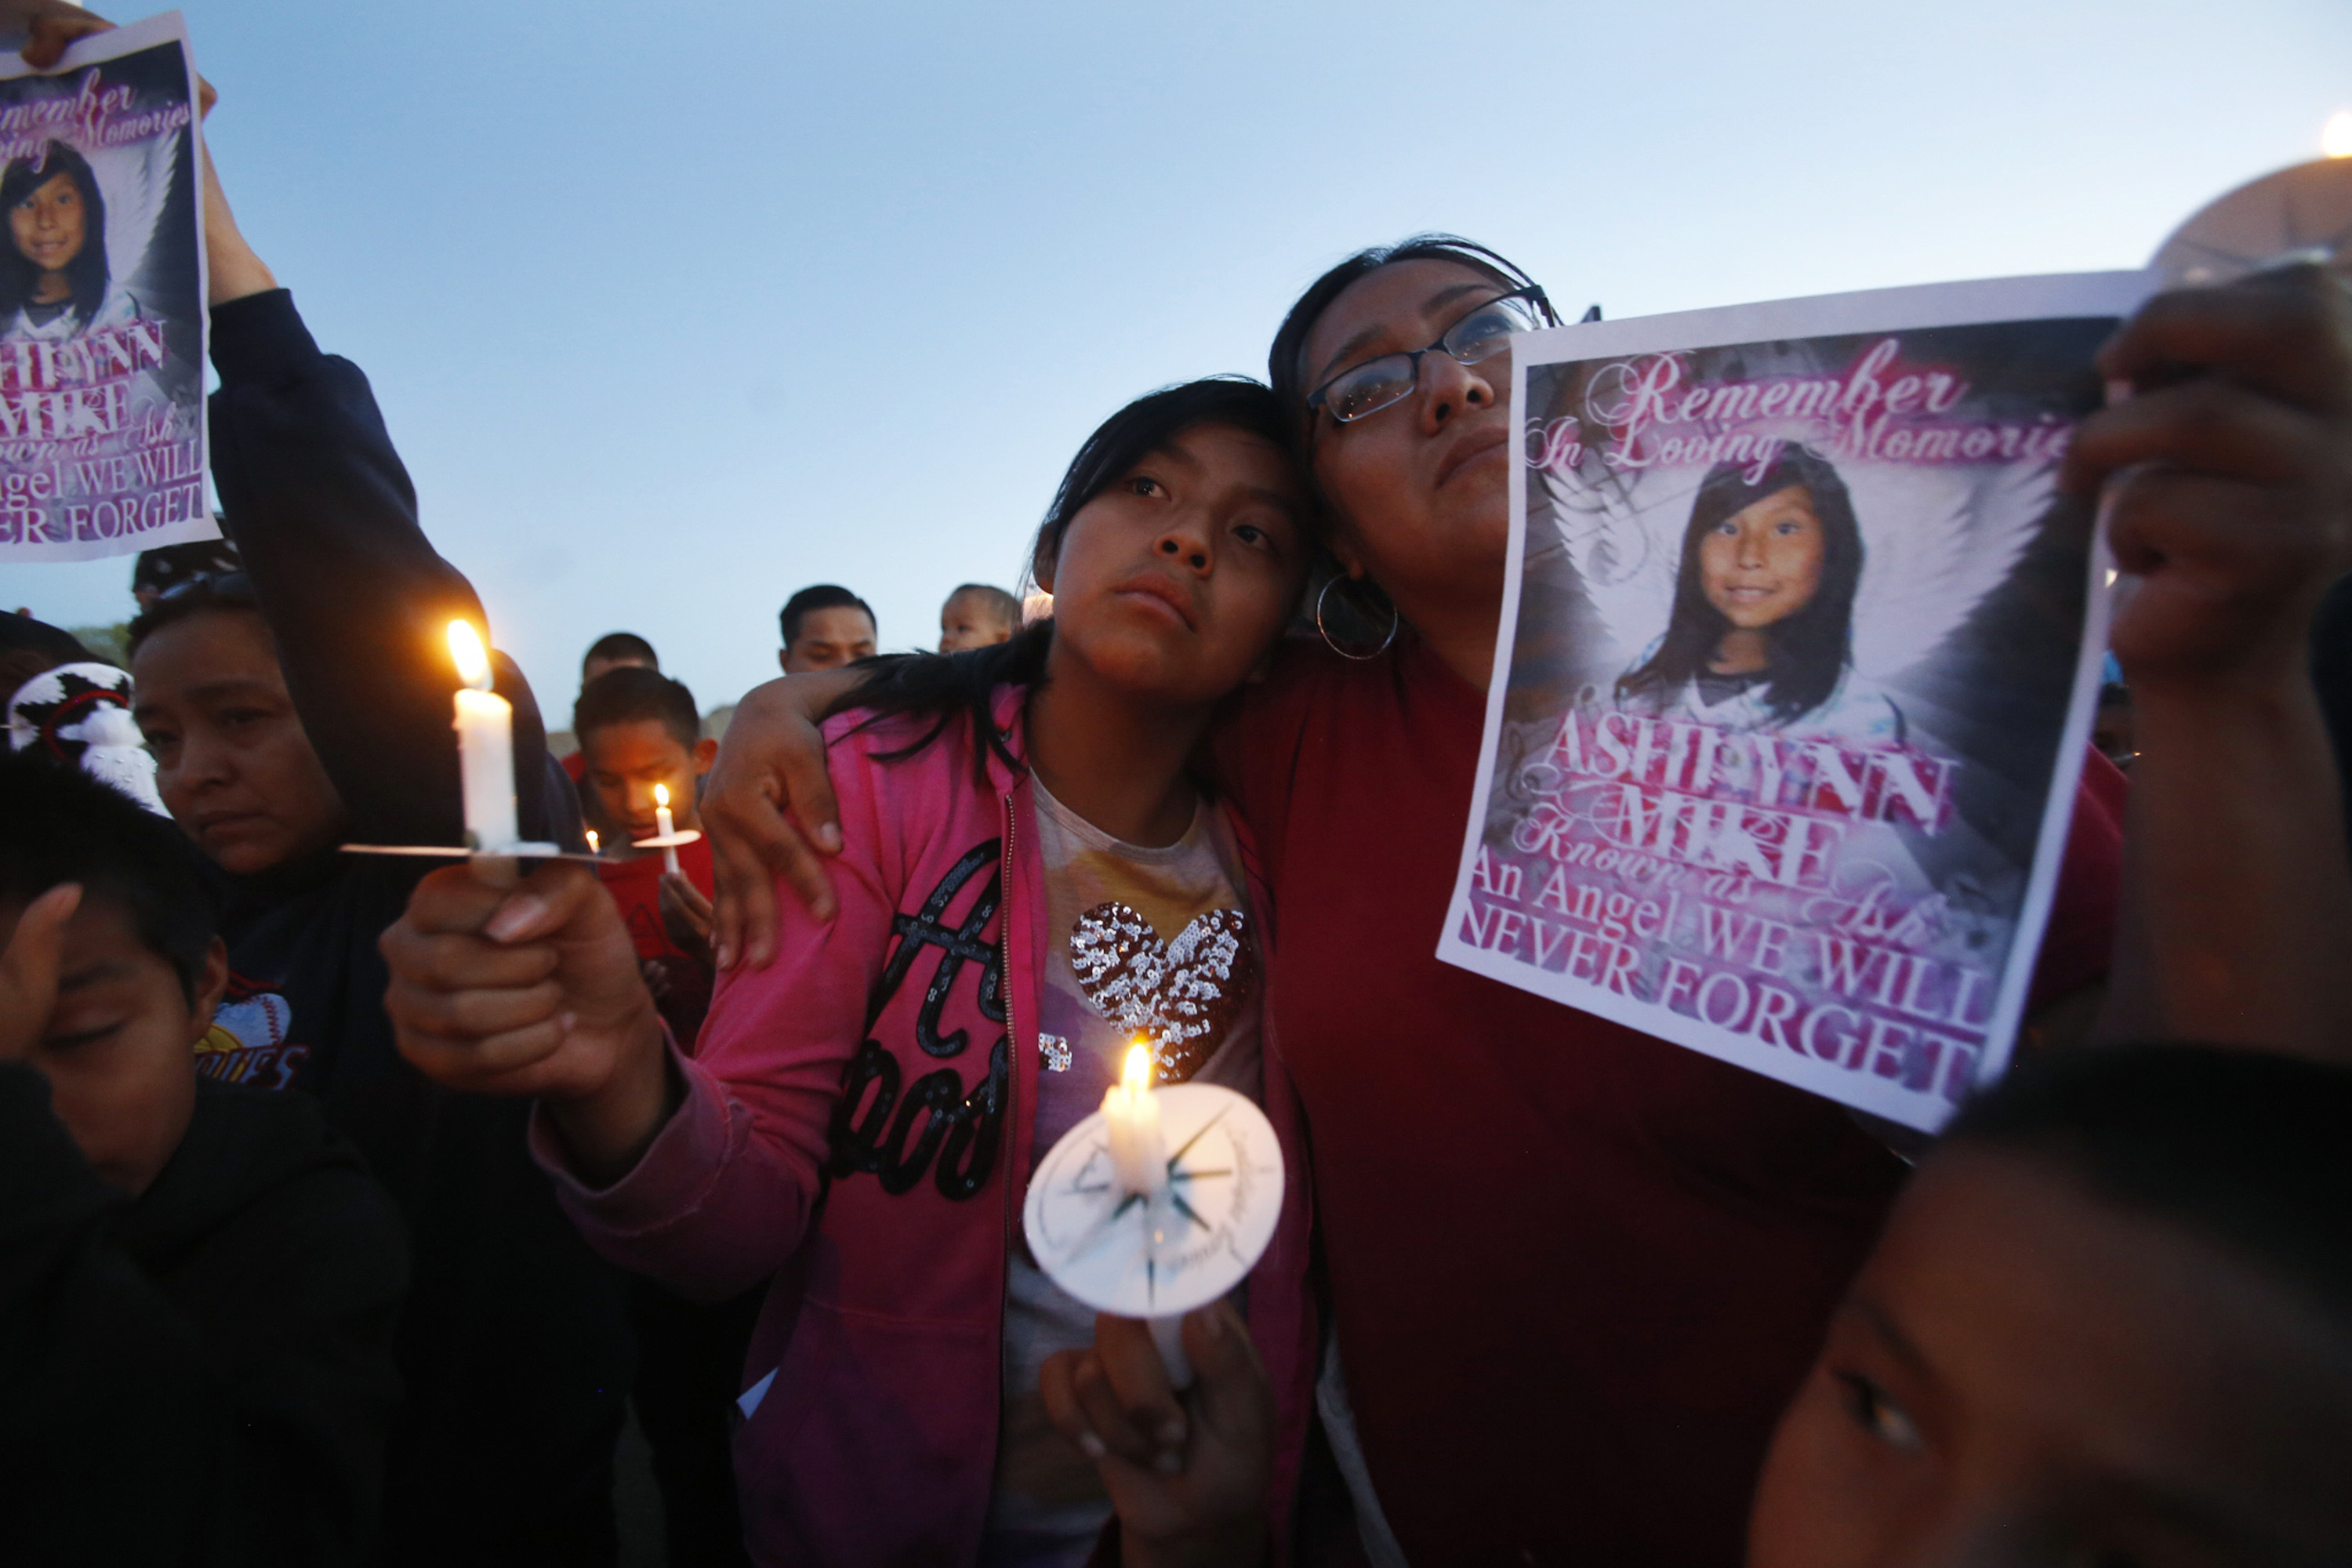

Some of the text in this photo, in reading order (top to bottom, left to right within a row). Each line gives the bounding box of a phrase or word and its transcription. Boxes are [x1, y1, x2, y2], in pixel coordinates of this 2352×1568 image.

[0, 67, 136, 130] member
[1585, 338, 1970, 425] Remember
[0, 439, 202, 510] gel WE WILL
[1526, 416, 1582, 469] In
[1604, 405, 1778, 485] Loving
[67, 481, 201, 541] FORGET
[1512, 802, 1683, 886] Known
[1468, 843, 1994, 1035] An Angel WE WILL
[1460, 896, 1980, 1101] NEVER FORGET
